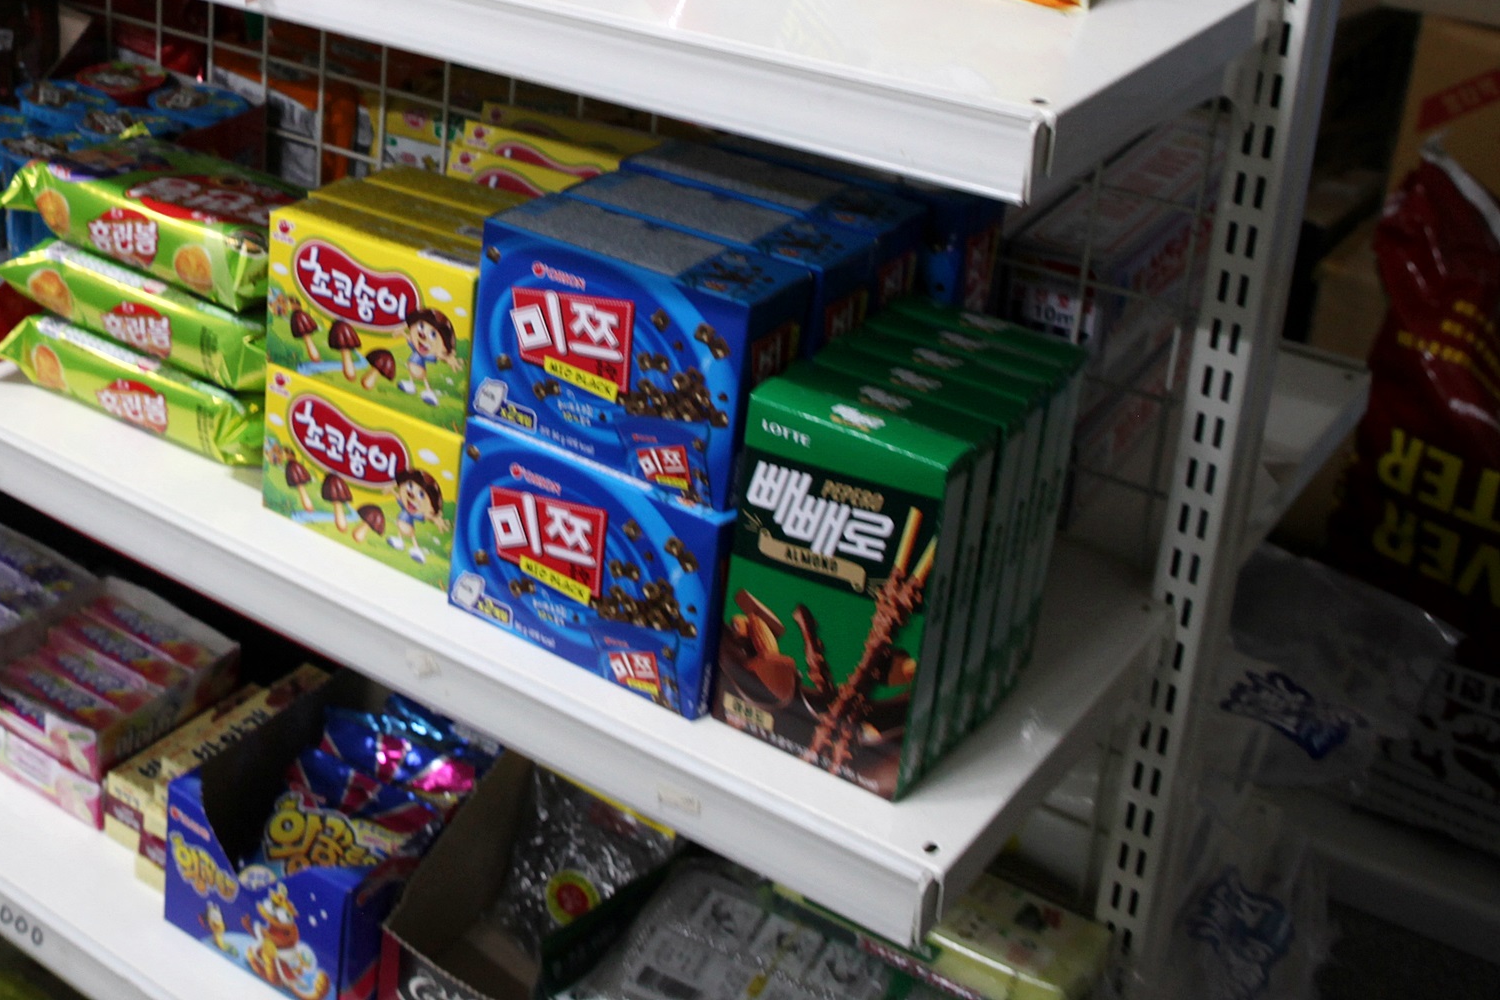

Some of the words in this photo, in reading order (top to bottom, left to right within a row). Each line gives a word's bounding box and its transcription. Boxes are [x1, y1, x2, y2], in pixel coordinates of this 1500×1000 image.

[300, 245, 408, 322] 초코송이
[510, 289, 624, 363] 미쯔
[283, 400, 398, 478] 초코송이
[761, 417, 812, 448] LOTTE
[488, 491, 597, 568] 미쯔
[746, 460, 895, 563] 빼빼로
[784, 546, 839, 573] ALMOND
